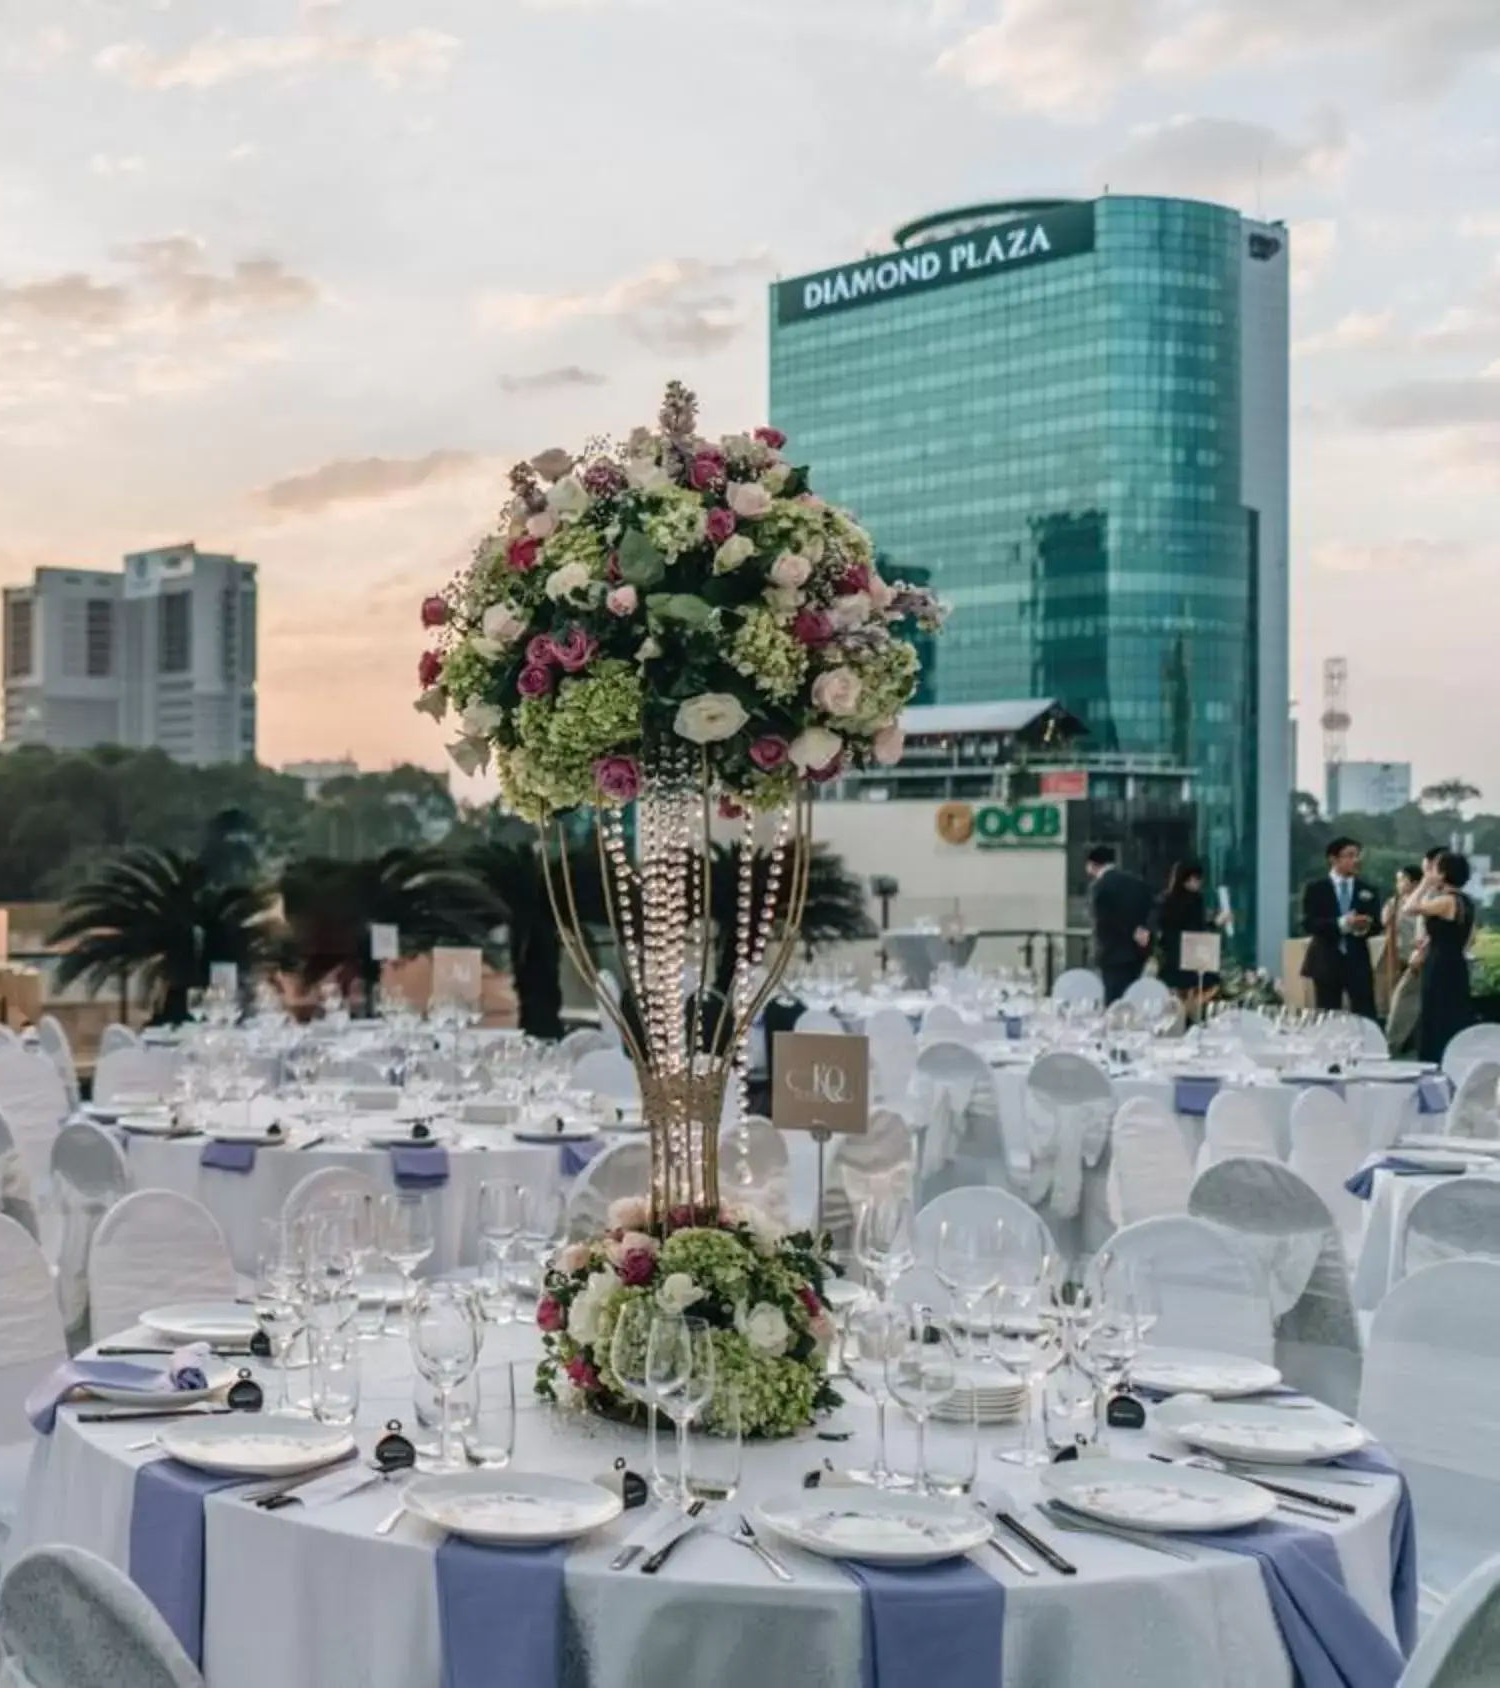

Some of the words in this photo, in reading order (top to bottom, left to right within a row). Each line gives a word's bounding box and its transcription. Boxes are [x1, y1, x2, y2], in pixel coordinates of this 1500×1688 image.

[803, 251, 942, 310] DIAMOND
[949, 223, 1051, 273] PLAZA
[977, 806, 1061, 837] OCB
